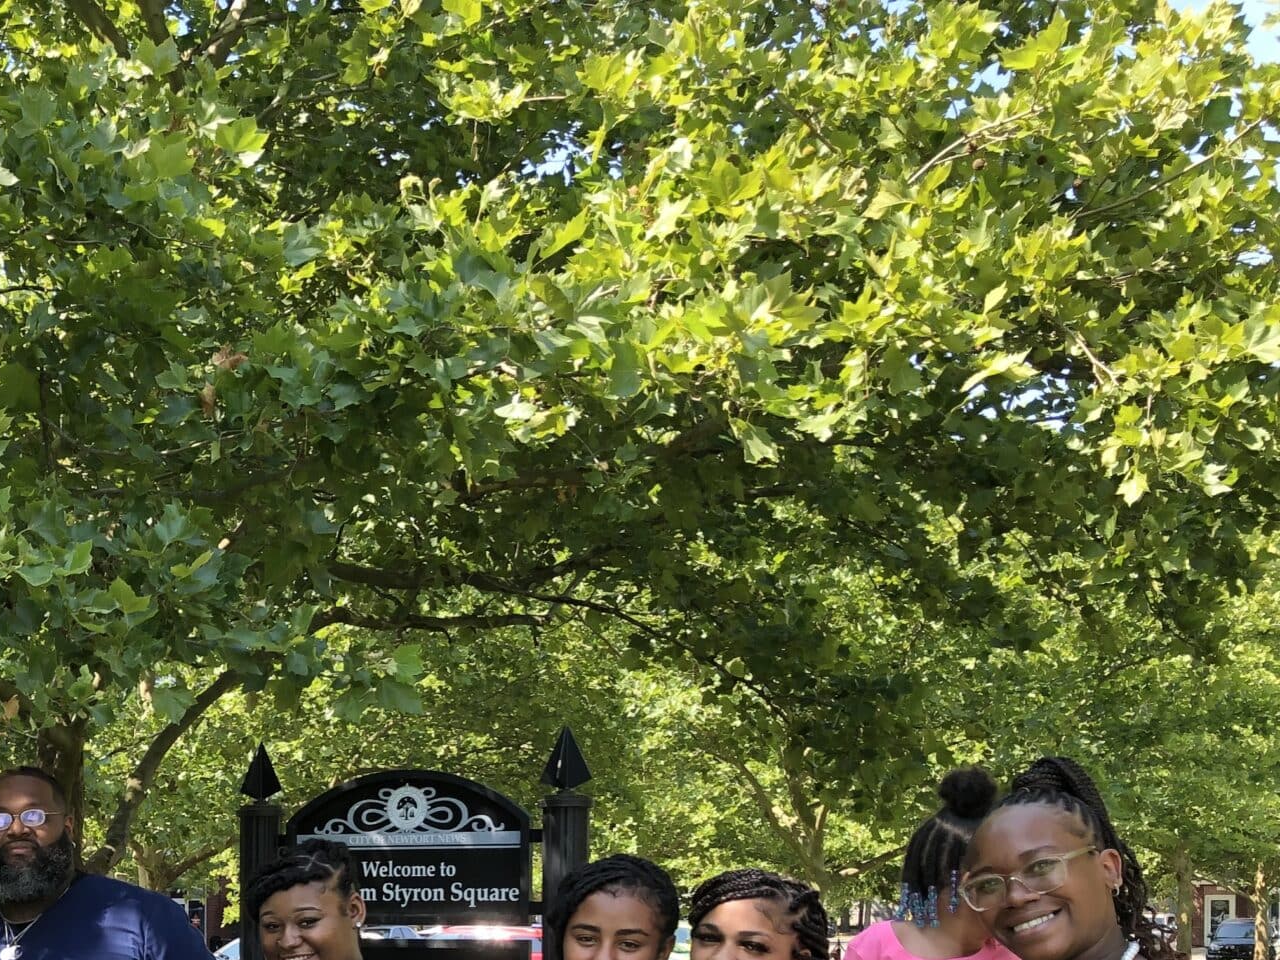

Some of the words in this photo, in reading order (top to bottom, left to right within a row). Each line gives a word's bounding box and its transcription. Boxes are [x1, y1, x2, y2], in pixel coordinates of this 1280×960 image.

[349, 835, 371, 845] CITY
[388, 834, 437, 844] NEWPORT
[438, 834, 466, 843] NEWS
[361, 861, 435, 878] Welcome
[440, 861, 456, 878] to
[382, 882, 445, 907] Styron
[450, 882, 520, 908] Square
